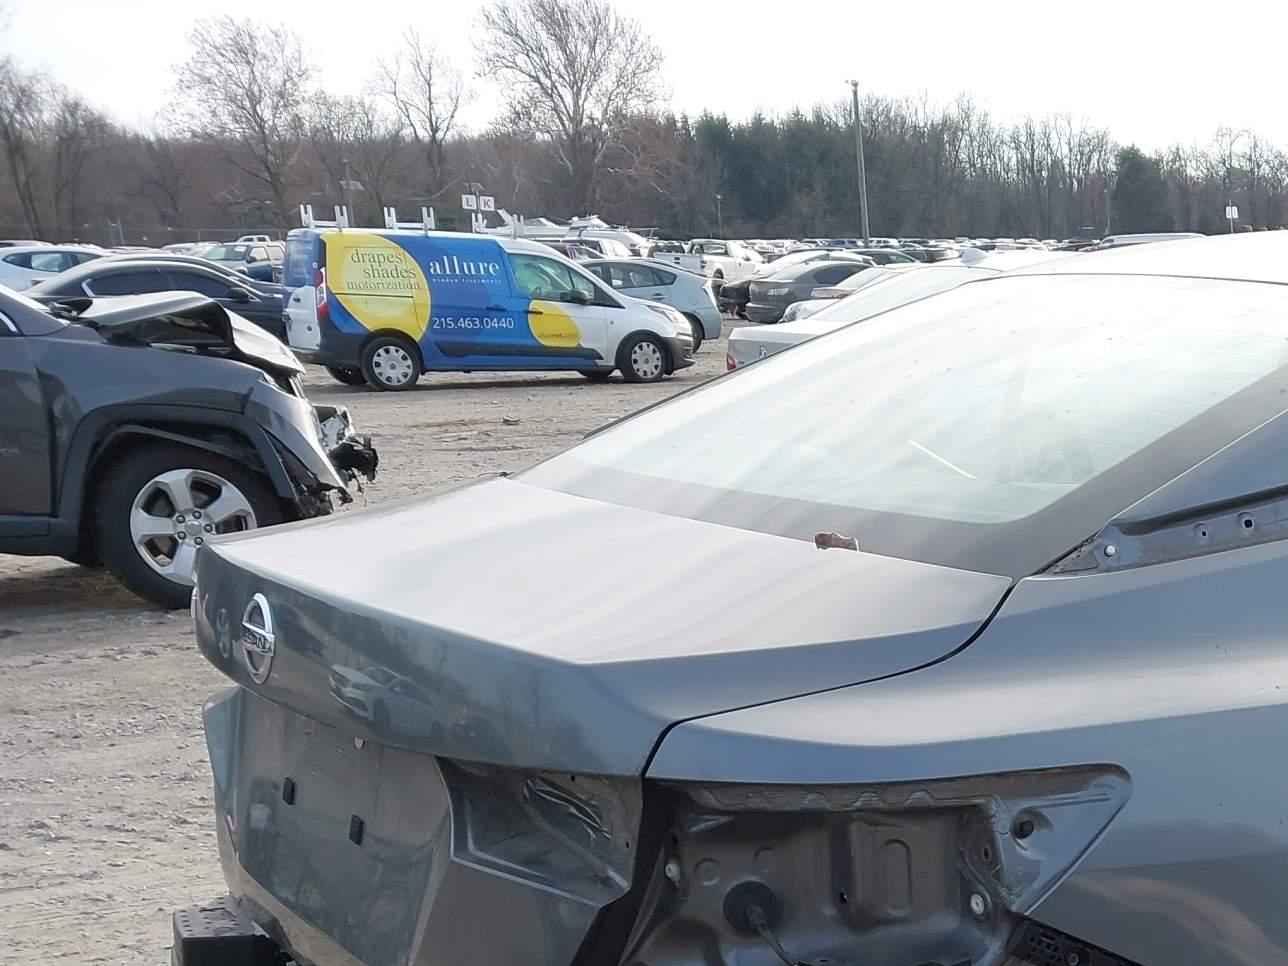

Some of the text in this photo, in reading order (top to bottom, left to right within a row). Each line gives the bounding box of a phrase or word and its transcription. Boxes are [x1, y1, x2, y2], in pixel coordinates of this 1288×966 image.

[351, 249, 403, 264] drapes
[363, 264, 416, 279] shades
[429, 255, 500, 276] allure
[347, 279, 420, 290] motorization
[432, 317, 514, 329] 215.463.0440
